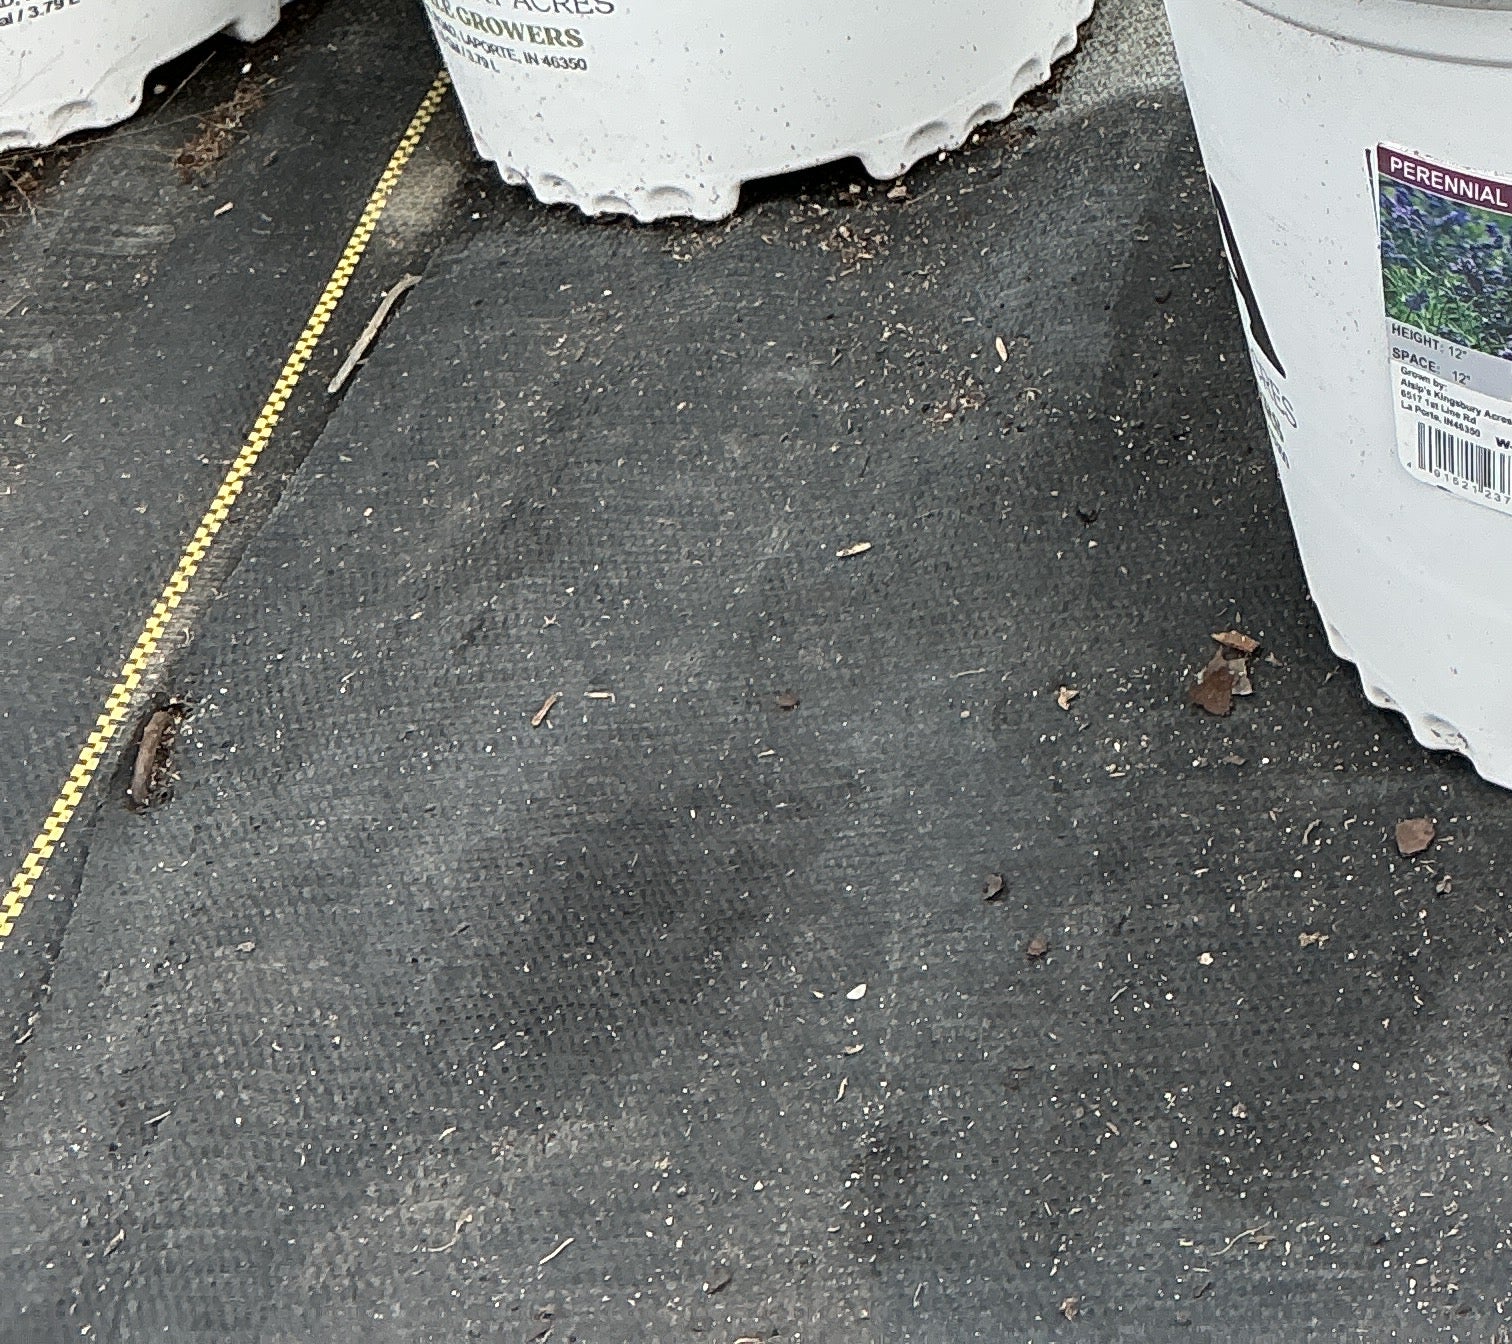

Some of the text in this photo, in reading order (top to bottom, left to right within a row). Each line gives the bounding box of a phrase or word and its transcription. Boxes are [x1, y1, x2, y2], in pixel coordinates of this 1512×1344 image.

[456, 6, 585, 49] GROWERS
[524, 50, 540, 67] IN
[542, 55, 588, 72] 46350
[1389, 156, 1508, 208] PERENNIAL
[1391, 322, 1468, 360] HEIGHT: 12"
[1391, 347, 1441, 375] SPACE:
[1401, 400, 1413, 412] La
[1434, 390, 1481, 417] Kingsbury
[1484, 409, 1512, 425] Acres
[1463, 413, 1477, 425] Rd
